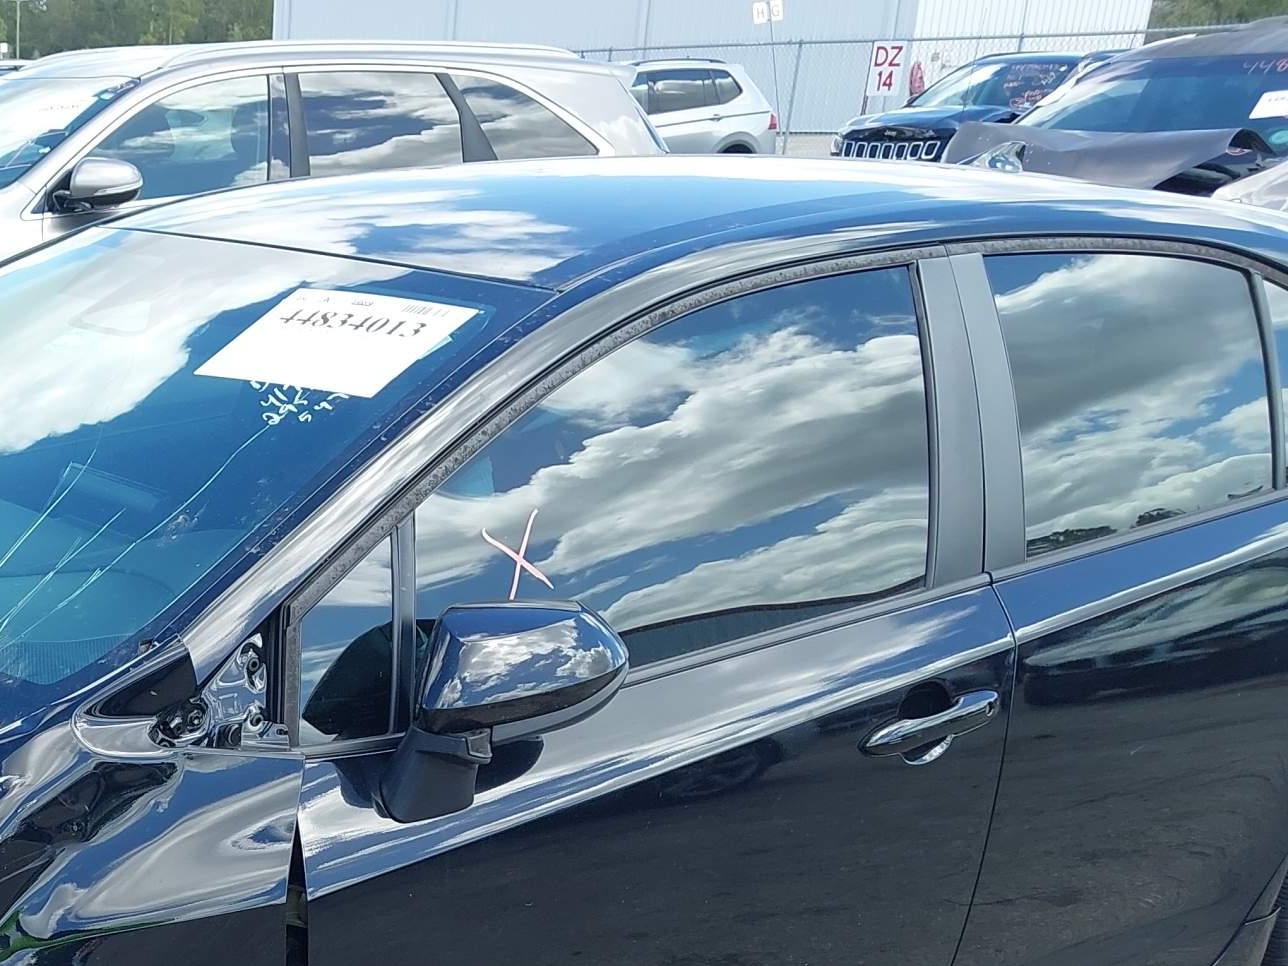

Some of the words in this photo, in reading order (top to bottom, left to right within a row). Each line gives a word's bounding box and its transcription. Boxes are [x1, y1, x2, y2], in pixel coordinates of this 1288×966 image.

[874, 46, 904, 67] DZ
[877, 70, 894, 92] 14
[280, 309, 427, 337] 44834013
